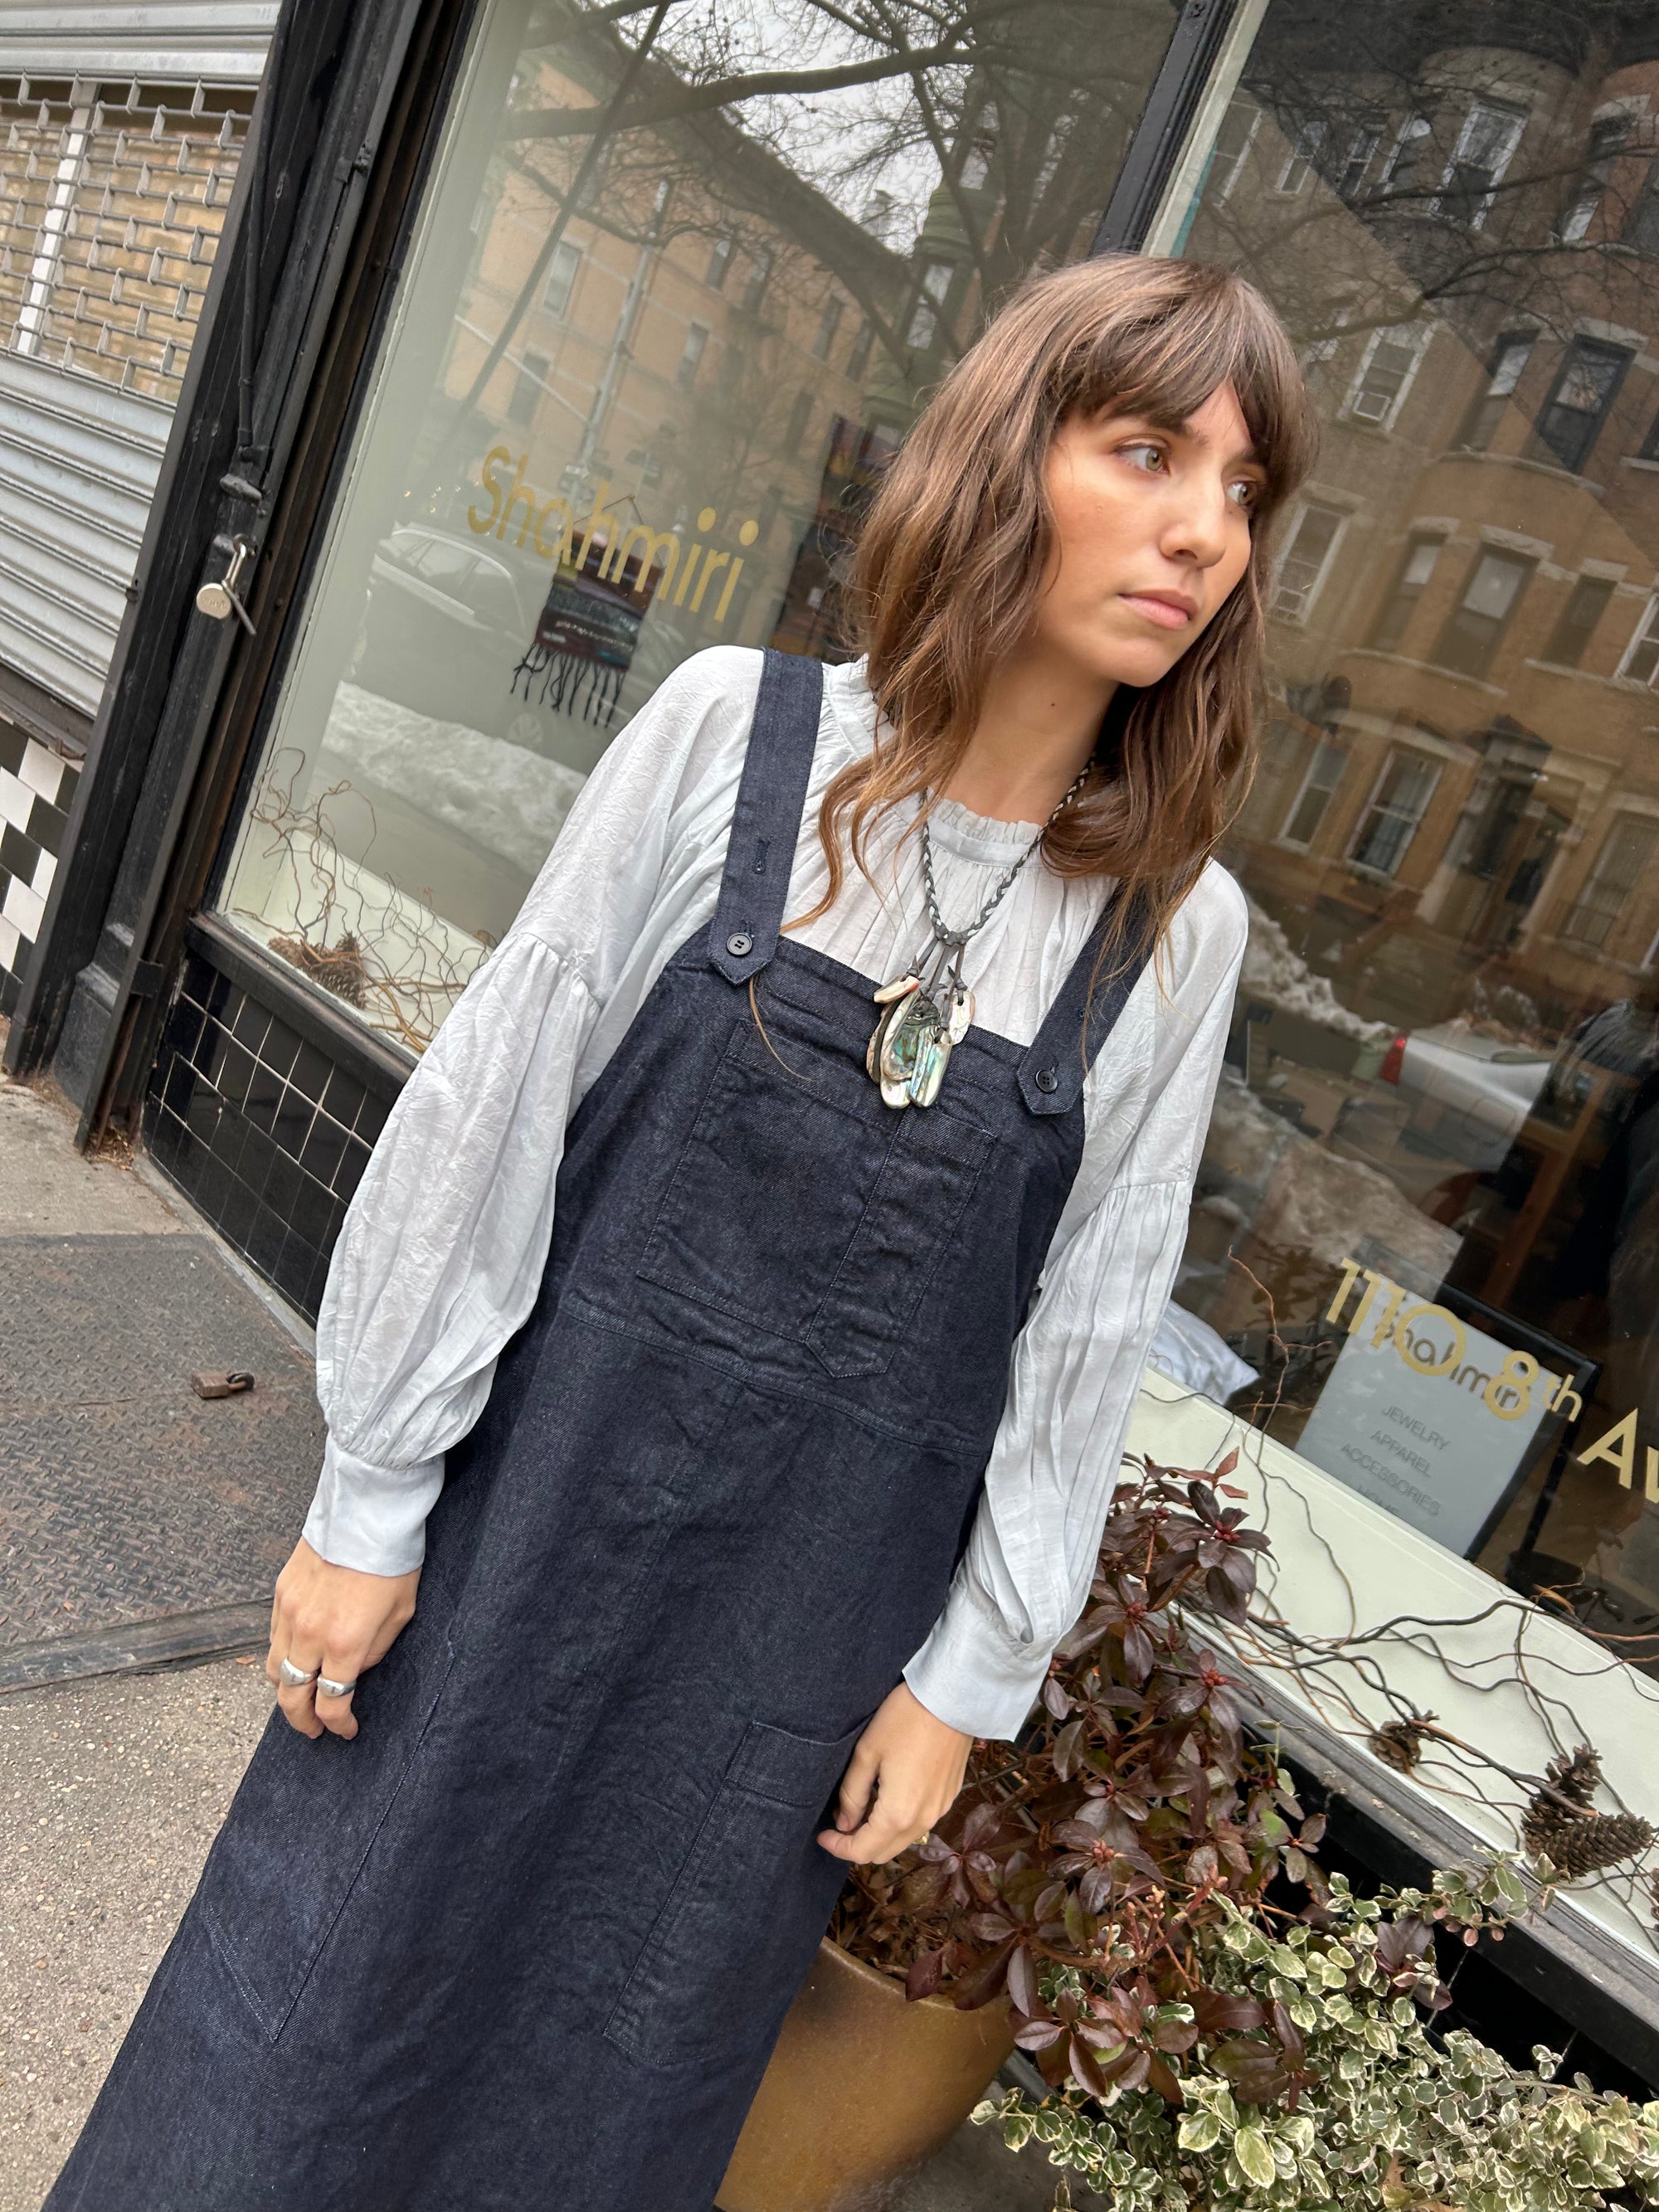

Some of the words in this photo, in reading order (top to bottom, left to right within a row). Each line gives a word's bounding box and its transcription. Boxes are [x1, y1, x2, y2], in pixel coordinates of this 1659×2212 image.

[467, 445, 760, 623] Shahmiri
[1326, 1257, 1467, 1377] 1110
[1483, 1349, 1584, 1422] 8th
[1370, 1429, 1432, 1478] APPAREL
[1381, 1404, 1452, 1451] JEWELRY
[1340, 1442, 1443, 1517] ACCESSORIES
